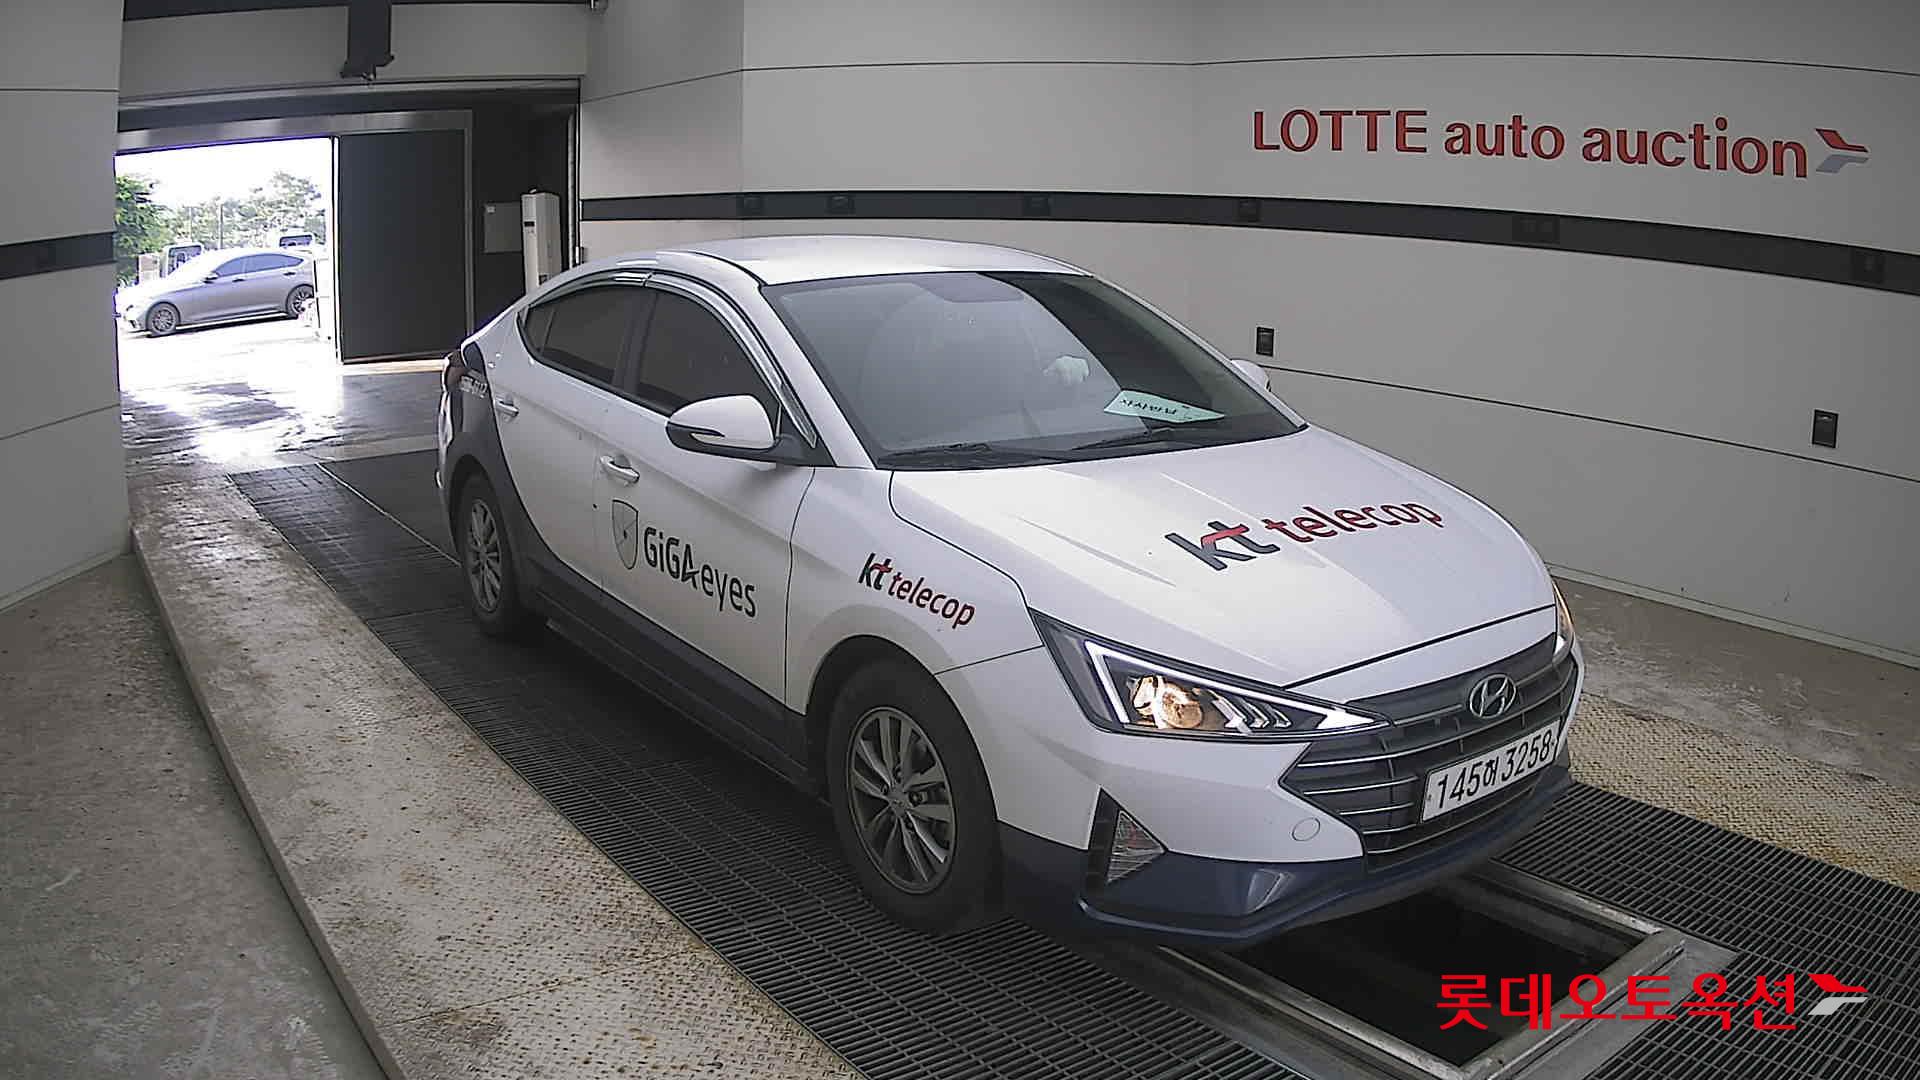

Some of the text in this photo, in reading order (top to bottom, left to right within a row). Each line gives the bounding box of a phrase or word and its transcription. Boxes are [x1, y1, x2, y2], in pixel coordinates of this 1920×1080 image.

[1253, 109, 1809, 178] LOTTE auto auction
[1164, 502, 1445, 571] kt telecop
[857, 552, 976, 630] kt telecop
